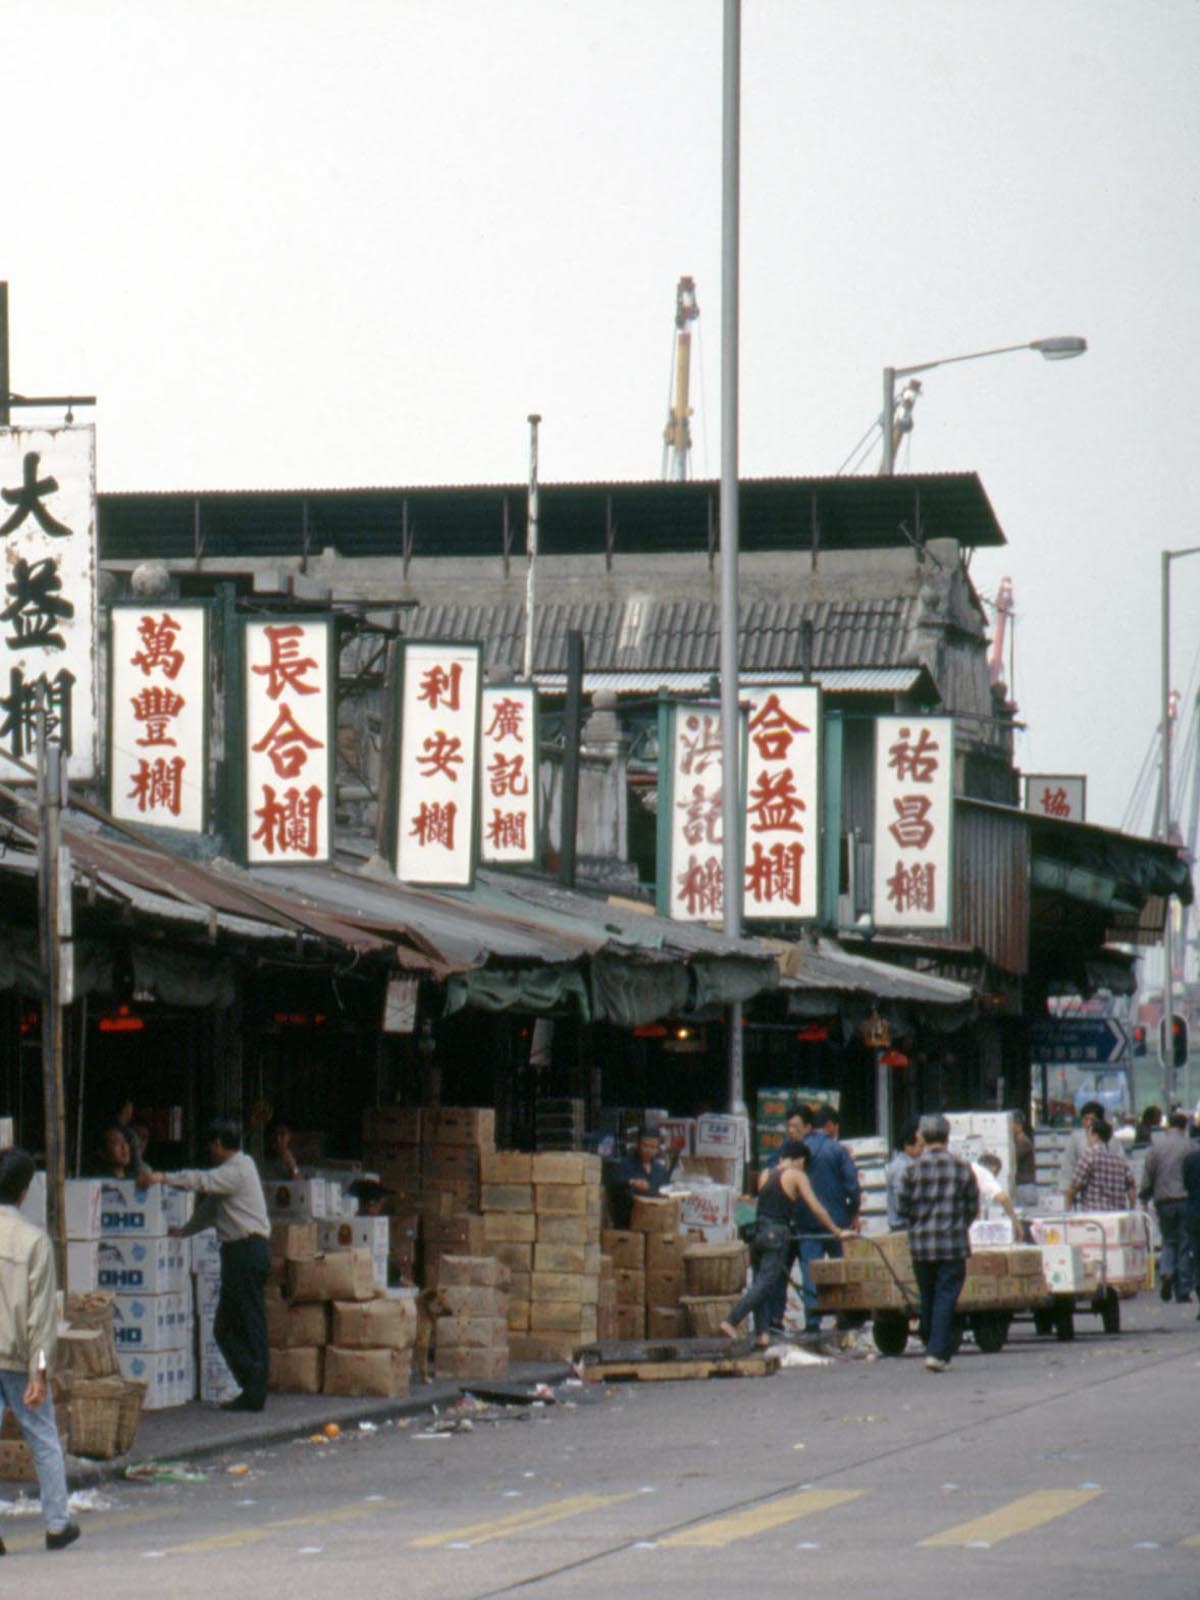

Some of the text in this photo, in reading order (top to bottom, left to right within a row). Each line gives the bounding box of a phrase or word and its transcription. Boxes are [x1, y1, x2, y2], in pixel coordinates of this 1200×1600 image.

[129, 612, 187, 816] 萬豐欄
[251, 625, 325, 858] 長合欄
[410, 661, 465, 852] 利安欄
[485, 697, 529, 852] 廣記欄
[746, 693, 810, 906] 合益欄
[886, 727, 939, 914] 祐昌欄
